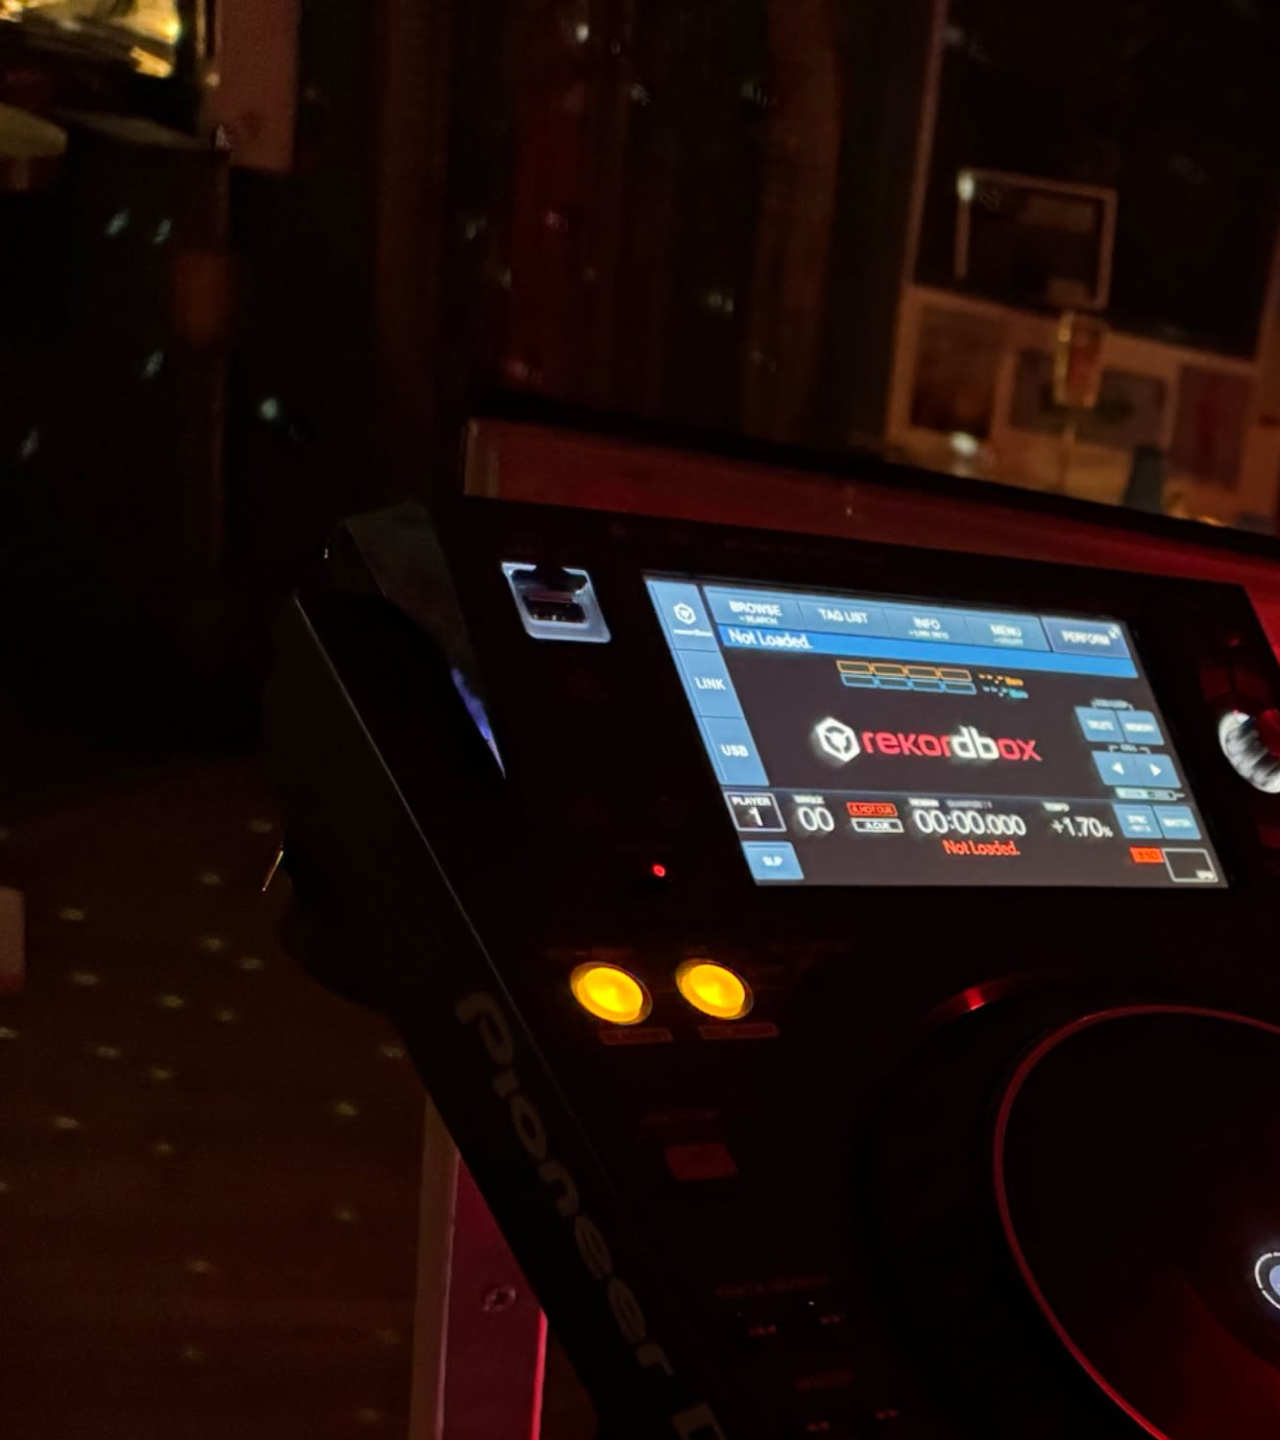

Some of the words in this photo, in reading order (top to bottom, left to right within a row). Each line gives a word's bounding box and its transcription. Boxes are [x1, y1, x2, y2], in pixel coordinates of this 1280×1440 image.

[728, 628, 757, 645] Not
[757, 630, 813, 649] Loaded.
[694, 676, 727, 691] LINK
[721, 744, 749, 758] USB
[861, 724, 1043, 762] rekordbox
[749, 808, 765, 827] 1
[798, 806, 835, 832] 00
[913, 808, 1027, 837] 00:00.000
[1051, 816, 1114, 838] +1.70%
[942, 839, 971, 855] Not
[971, 840, 1021, 856] Loaded.
[455, 991, 675, 1376] Pioneer
